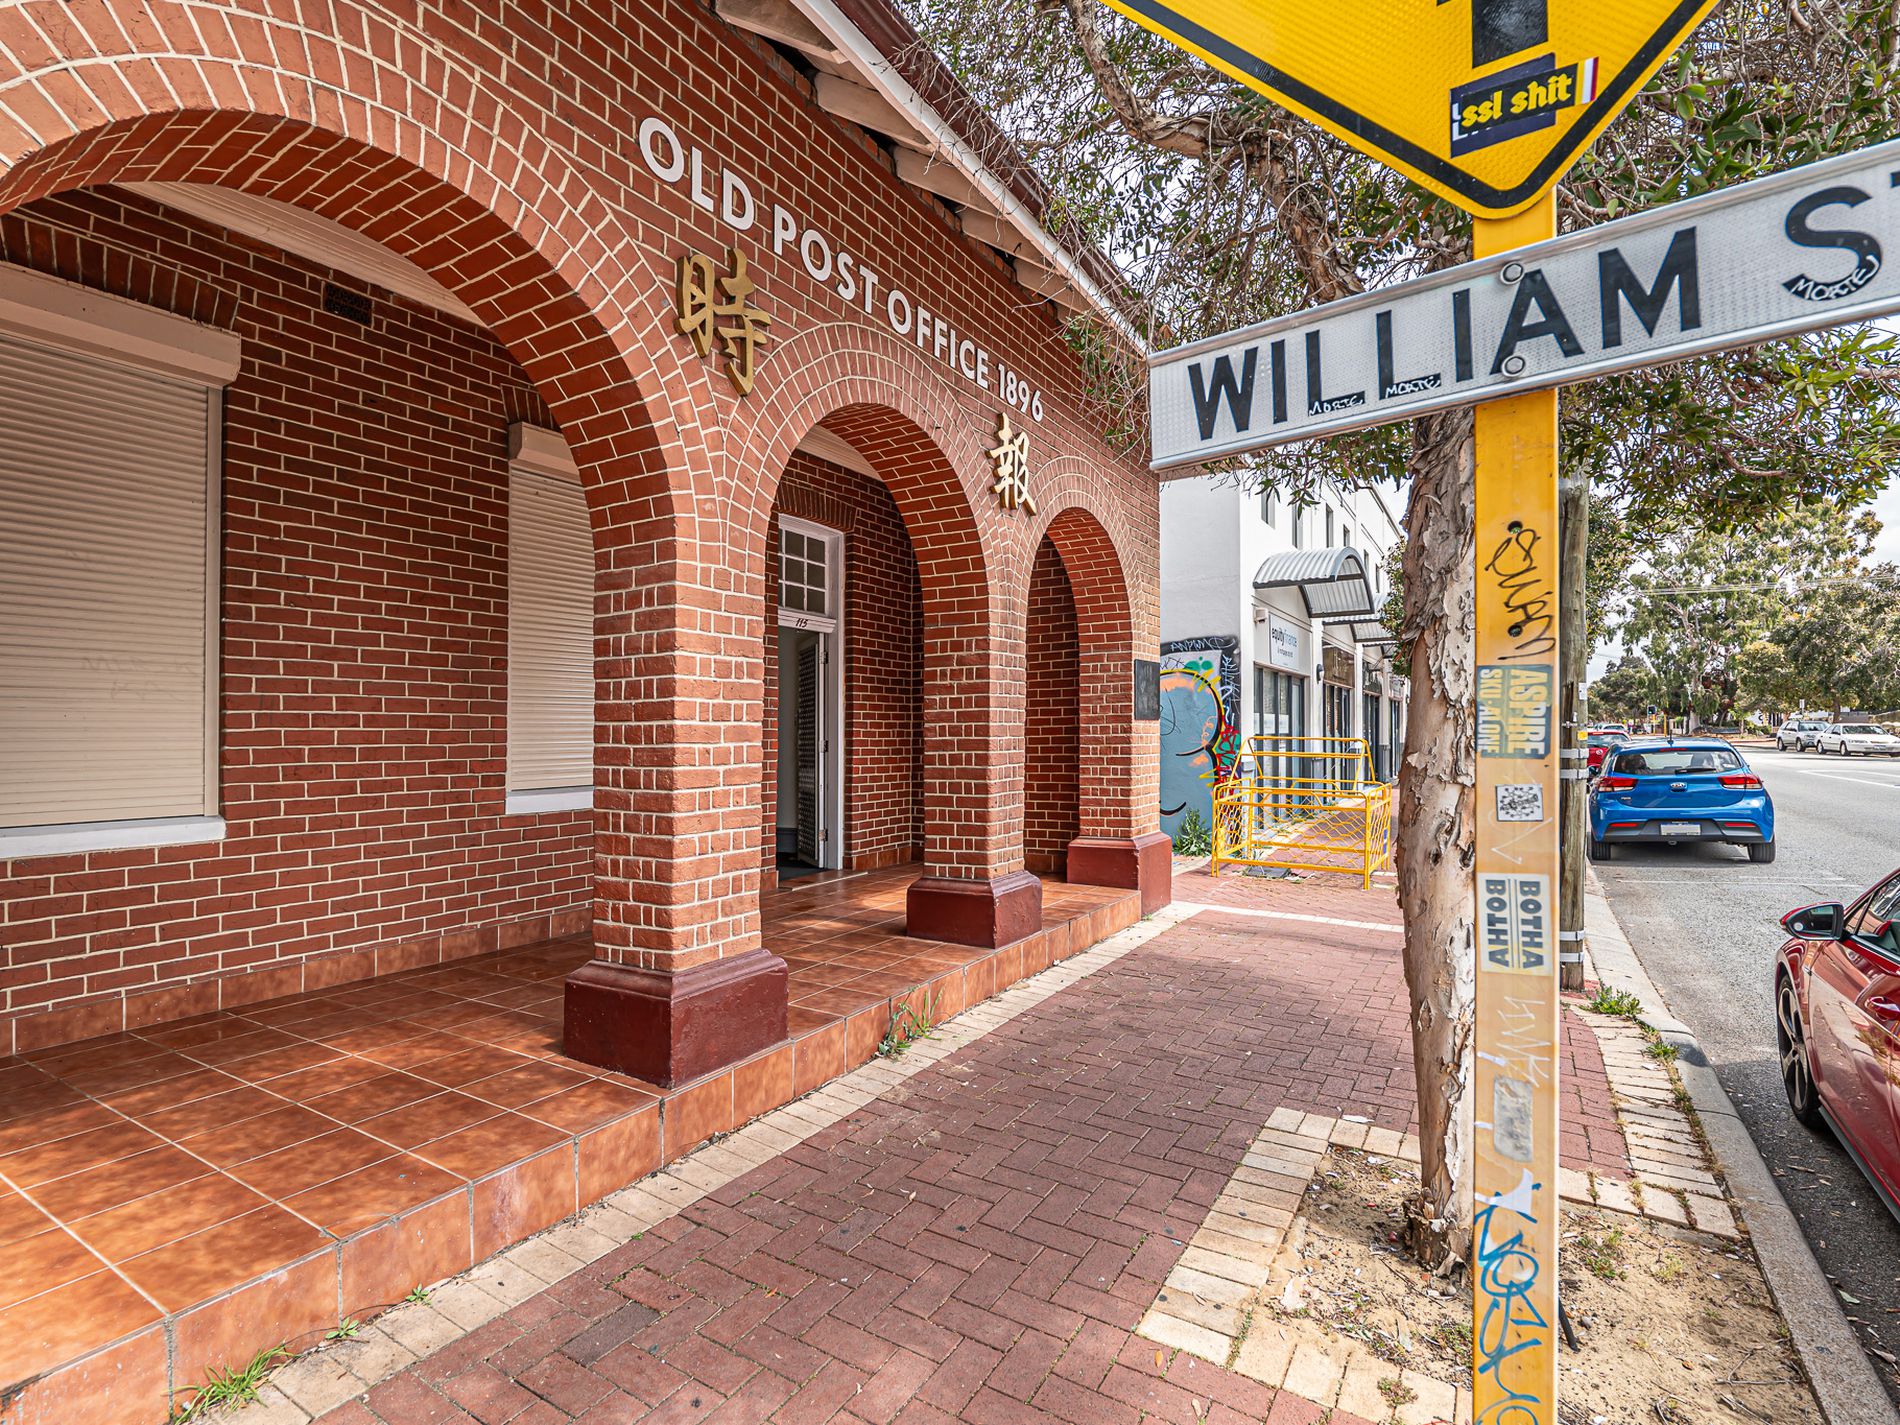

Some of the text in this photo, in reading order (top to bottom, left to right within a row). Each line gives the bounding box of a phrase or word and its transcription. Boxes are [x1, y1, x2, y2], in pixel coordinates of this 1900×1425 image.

[1461, 90, 1503, 127] ssl
[1510, 73, 1573, 114] shit
[639, 117, 1044, 422] OLD POST OFFICE 1896
[1187, 171, 1900, 441] WILLIAM S
[674, 248, 1037, 516] 時 報
[795, 617, 808, 628] 115
[1507, 668, 1549, 755] ASPIRE
[1518, 880, 1545, 969] BOTHA
